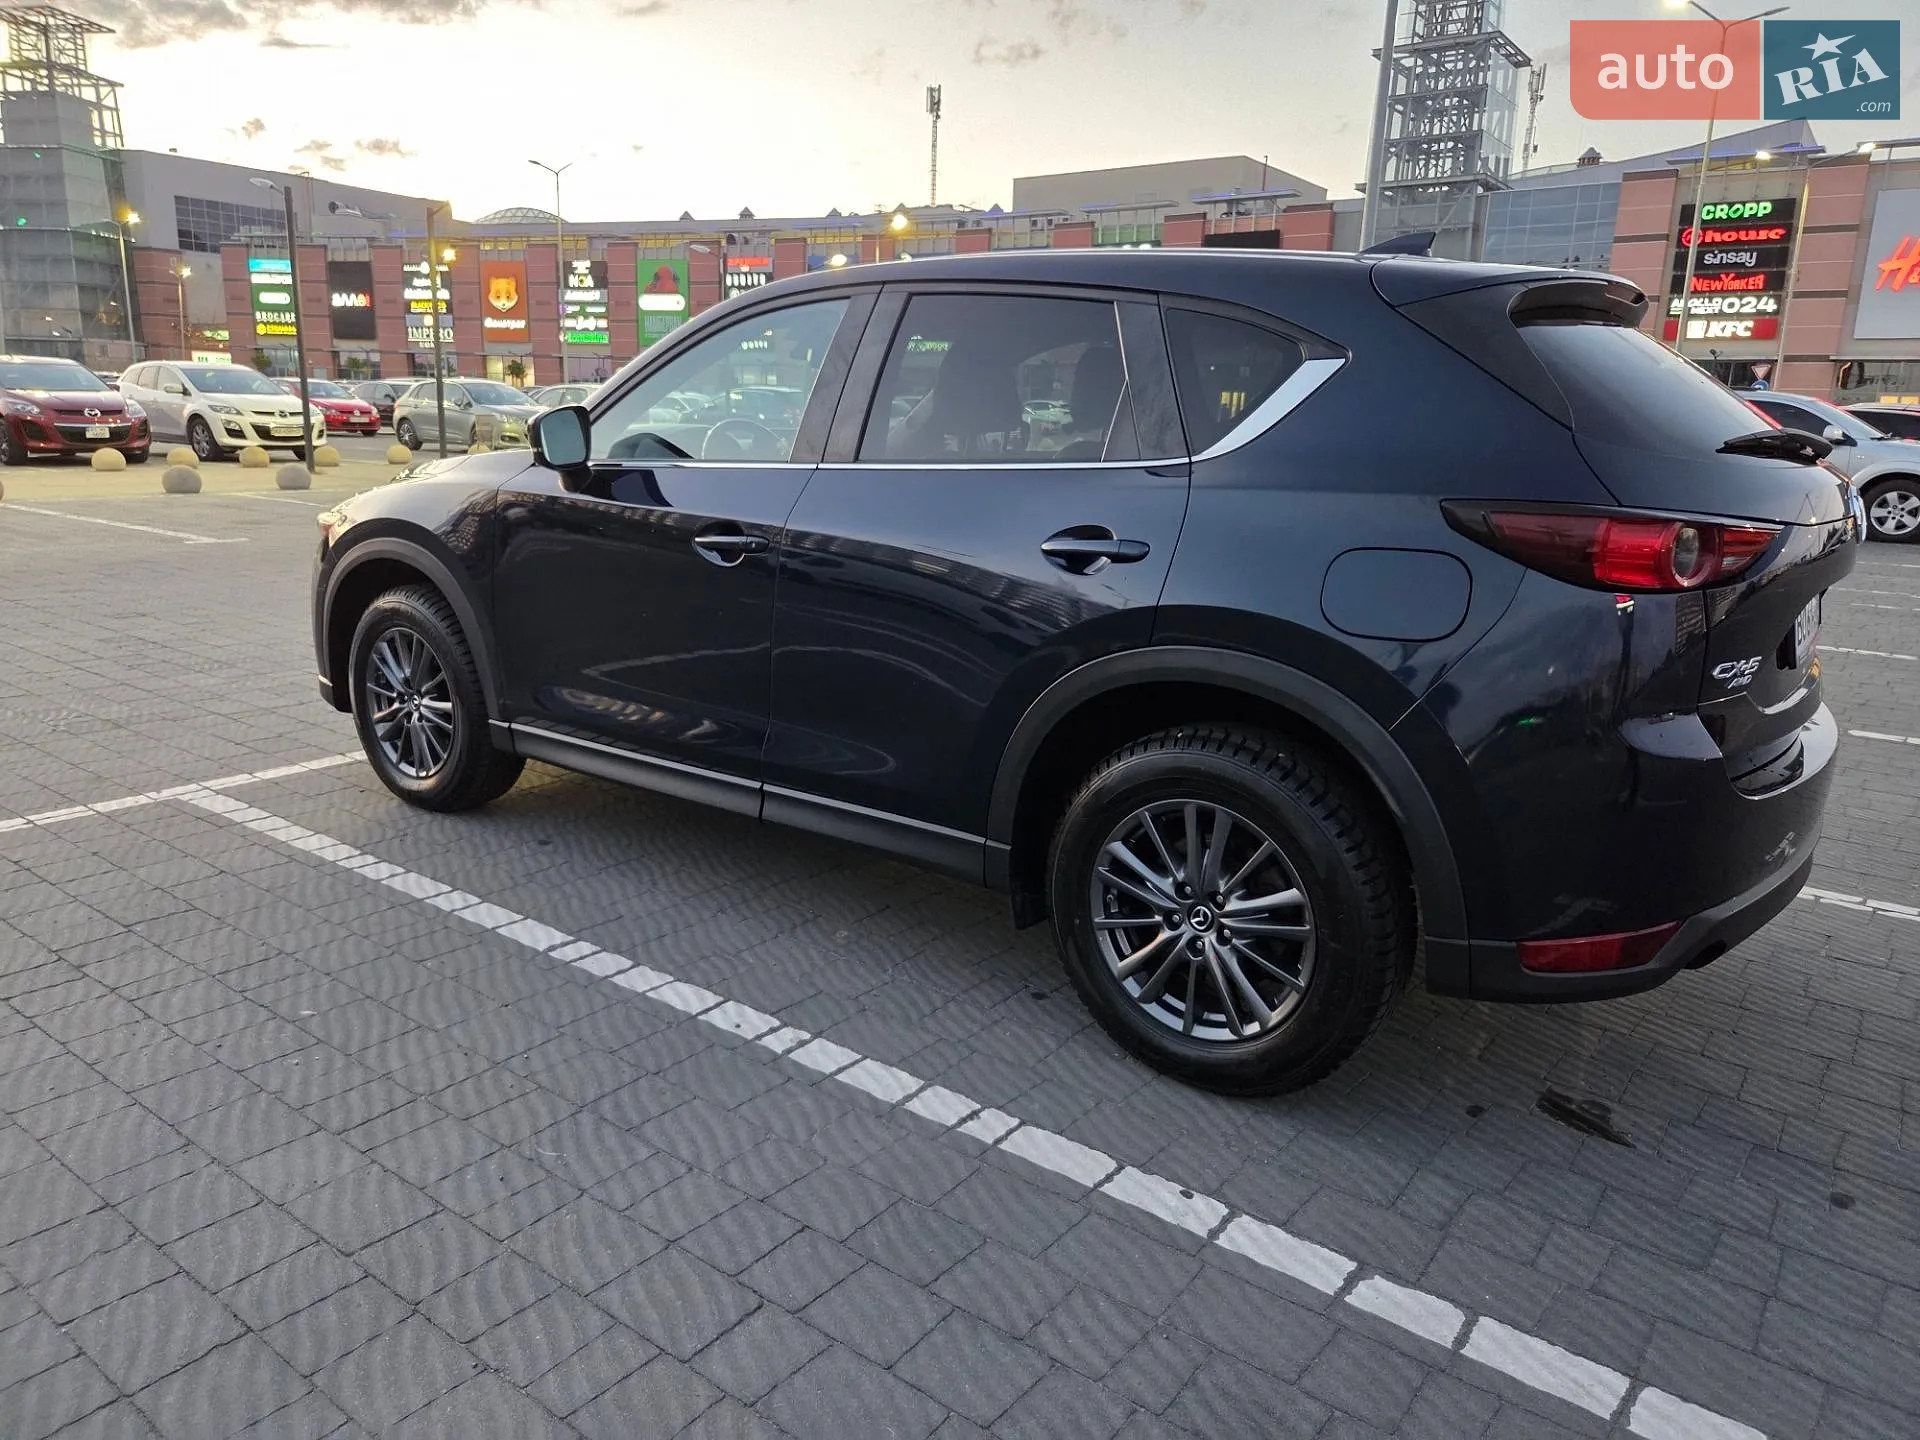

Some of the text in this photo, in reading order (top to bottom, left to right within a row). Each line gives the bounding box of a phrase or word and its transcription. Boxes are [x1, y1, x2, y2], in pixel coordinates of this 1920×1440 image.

[1701, 201, 1772, 220] CROPP
[1704, 228, 1786, 243] house
[1704, 250, 1757, 266] sinsay
[1705, 320, 1755, 337] KFC
[1712, 656, 1762, 679] CX-5
